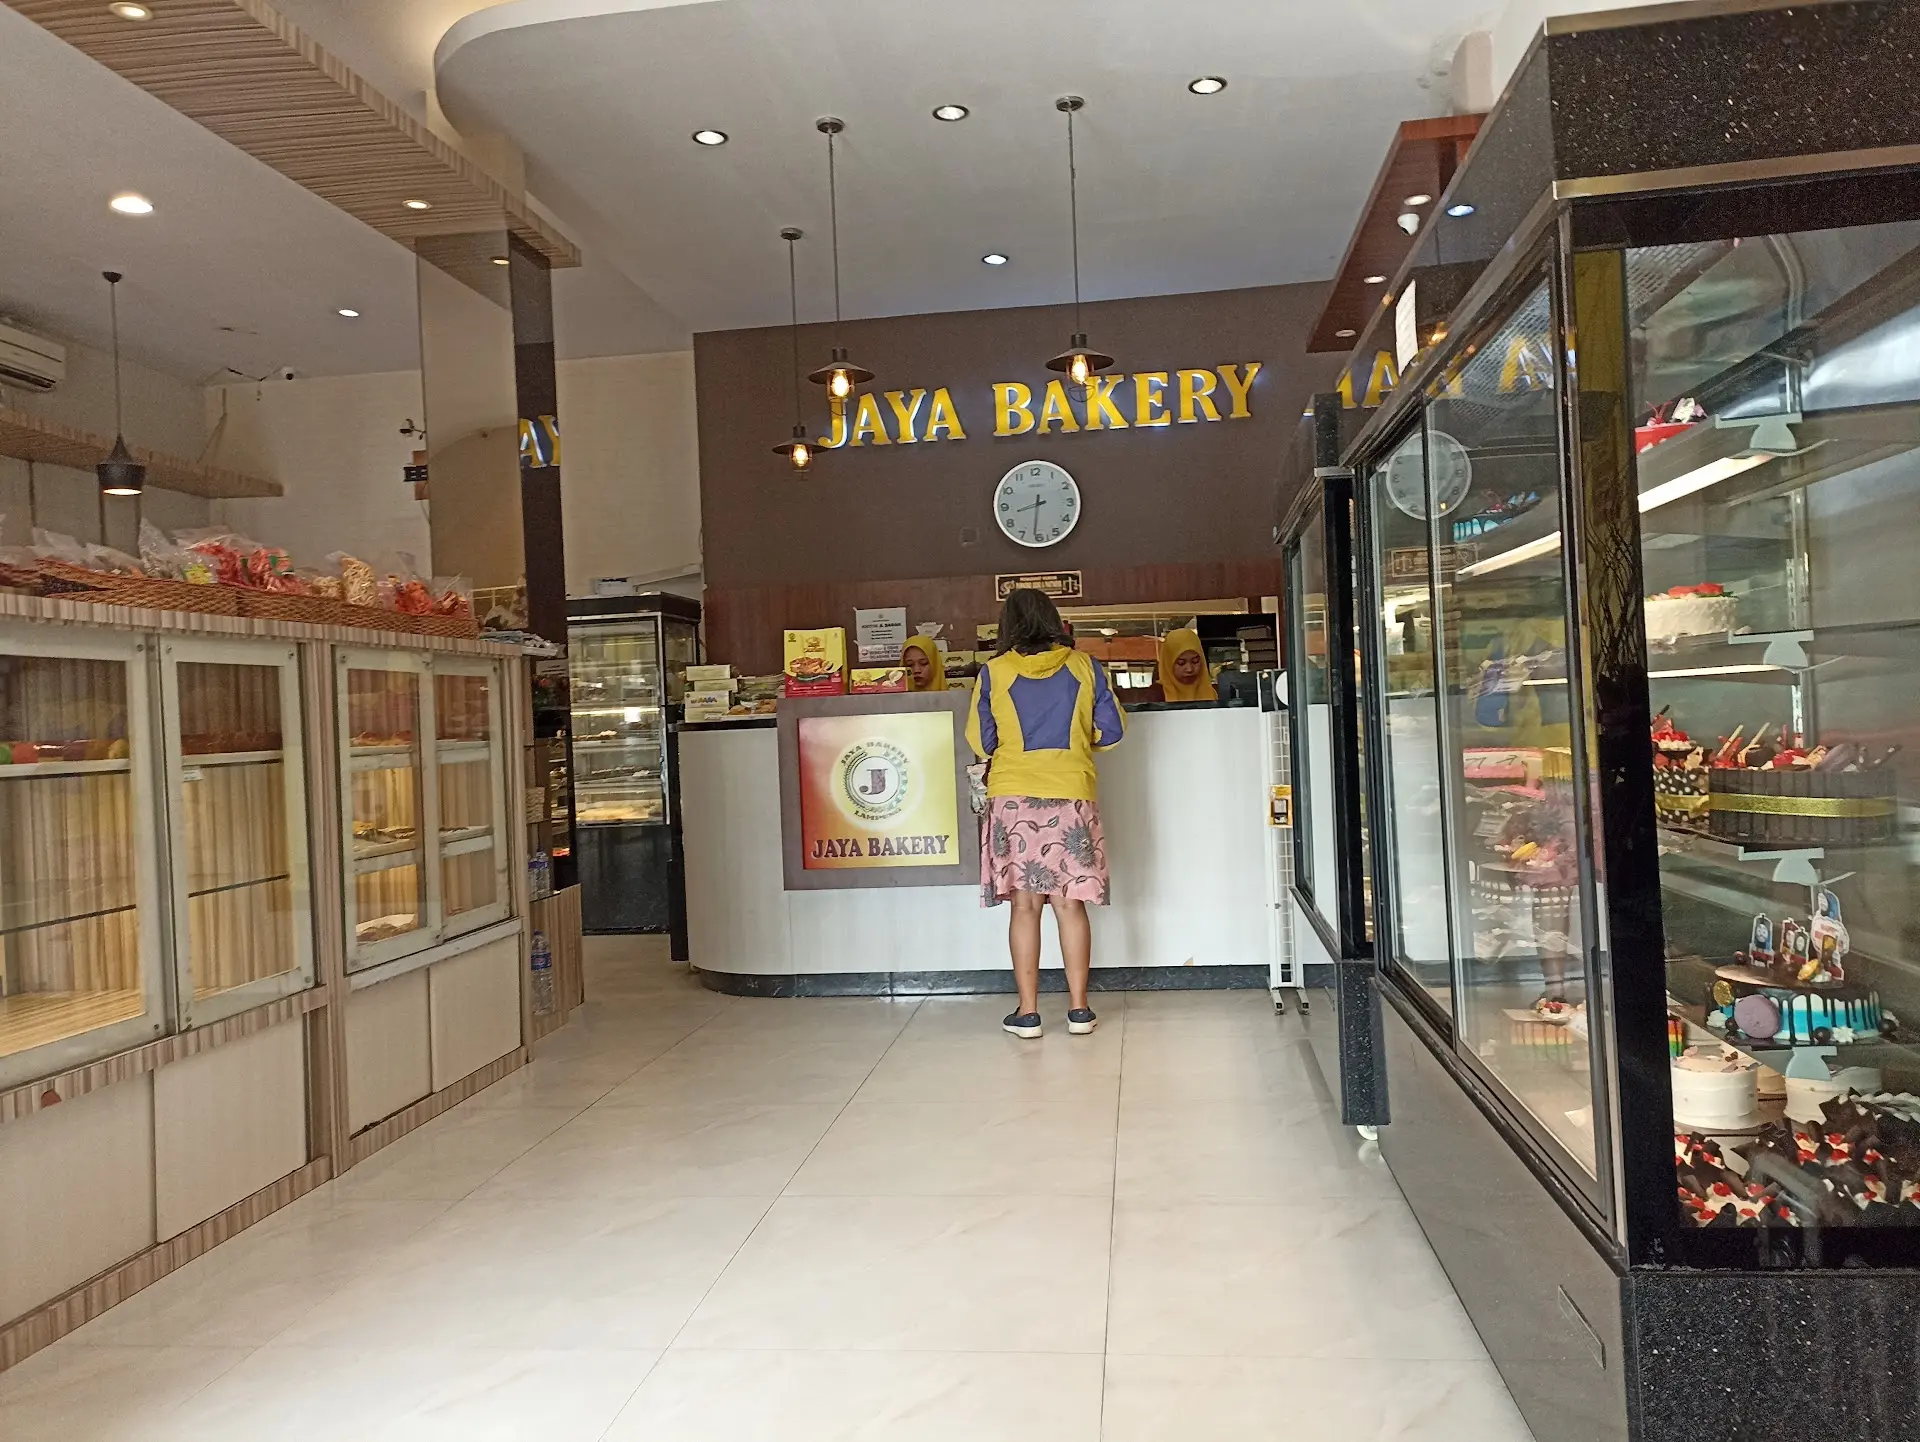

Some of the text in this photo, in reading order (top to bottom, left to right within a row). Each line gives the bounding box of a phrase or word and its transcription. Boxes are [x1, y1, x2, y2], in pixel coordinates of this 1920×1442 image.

[817, 387, 967, 449] JAYA
[992, 362, 1263, 437] BAKERY
[1030, 467, 1041, 477] 12
[1015, 473, 1023, 482] 11
[1061, 481, 1070, 490] 2
[1003, 486, 1014, 496] 10
[1000, 502, 1010, 512] 9
[1066, 497, 1075, 507] 3
[1006, 518, 1015, 528] 8
[1061, 513, 1070, 523] 4
[1018, 530, 1026, 540] 7
[1051, 527, 1060, 537] 5
[1034, 533, 1044, 542] 6
[841, 744, 862, 766] JAYA
[859, 768, 889, 796] J
[812, 834, 950, 858] JAYA BAKERY
